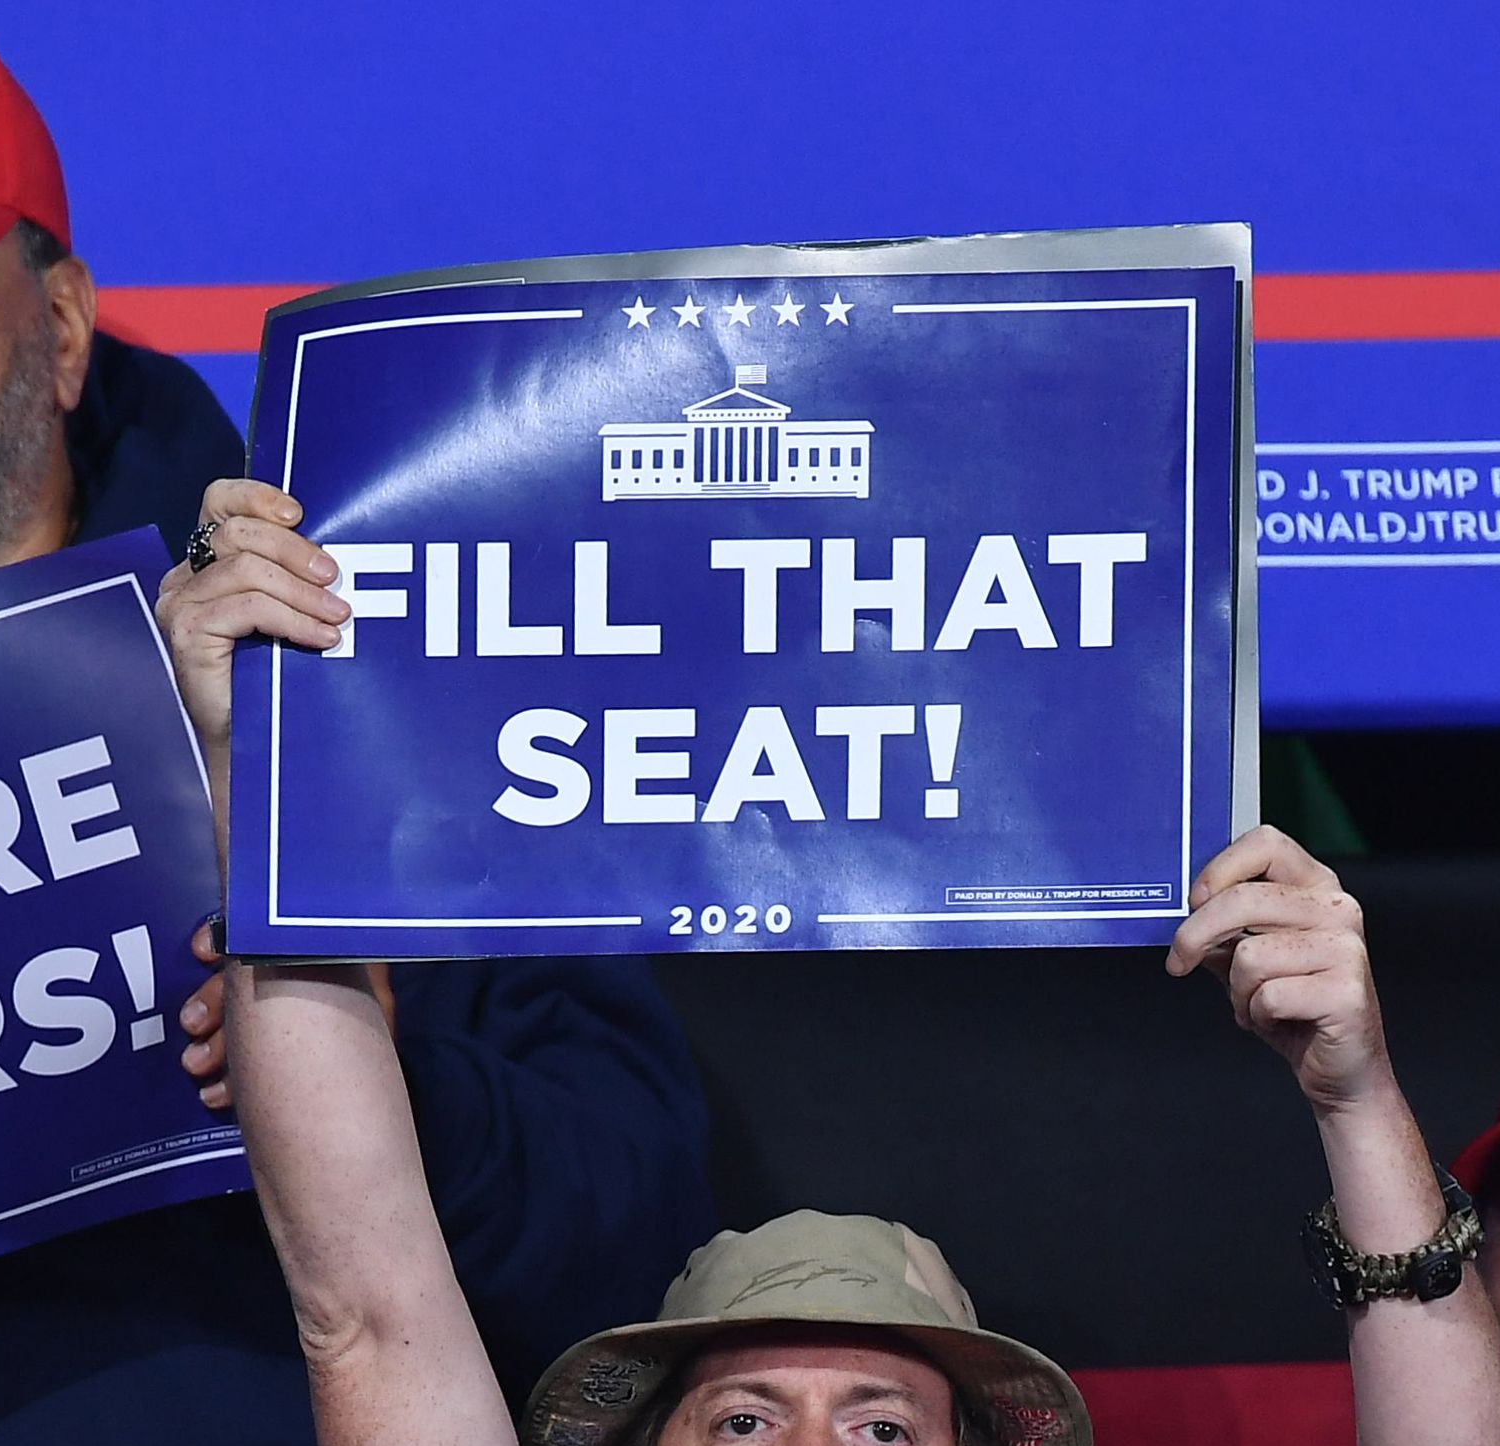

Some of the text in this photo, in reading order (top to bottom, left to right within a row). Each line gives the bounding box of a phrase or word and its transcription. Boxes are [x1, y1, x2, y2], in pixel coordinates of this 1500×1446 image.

[1299, 469, 1330, 501] J.
[1340, 467, 1479, 501] TRUMP
[319, 533, 1147, 658] FILL THAT
[492, 704, 963, 827] SEAT!
[954, 892, 975, 900] PAID
[976, 891, 994, 900] FOR
[995, 891, 1007, 900] BY
[1007, 890, 1043, 900] DONALD
[1053, 890, 1081, 899] TRUMP
[1082, 890, 1100, 899] FOR
[669, 904, 793, 935] 2020
